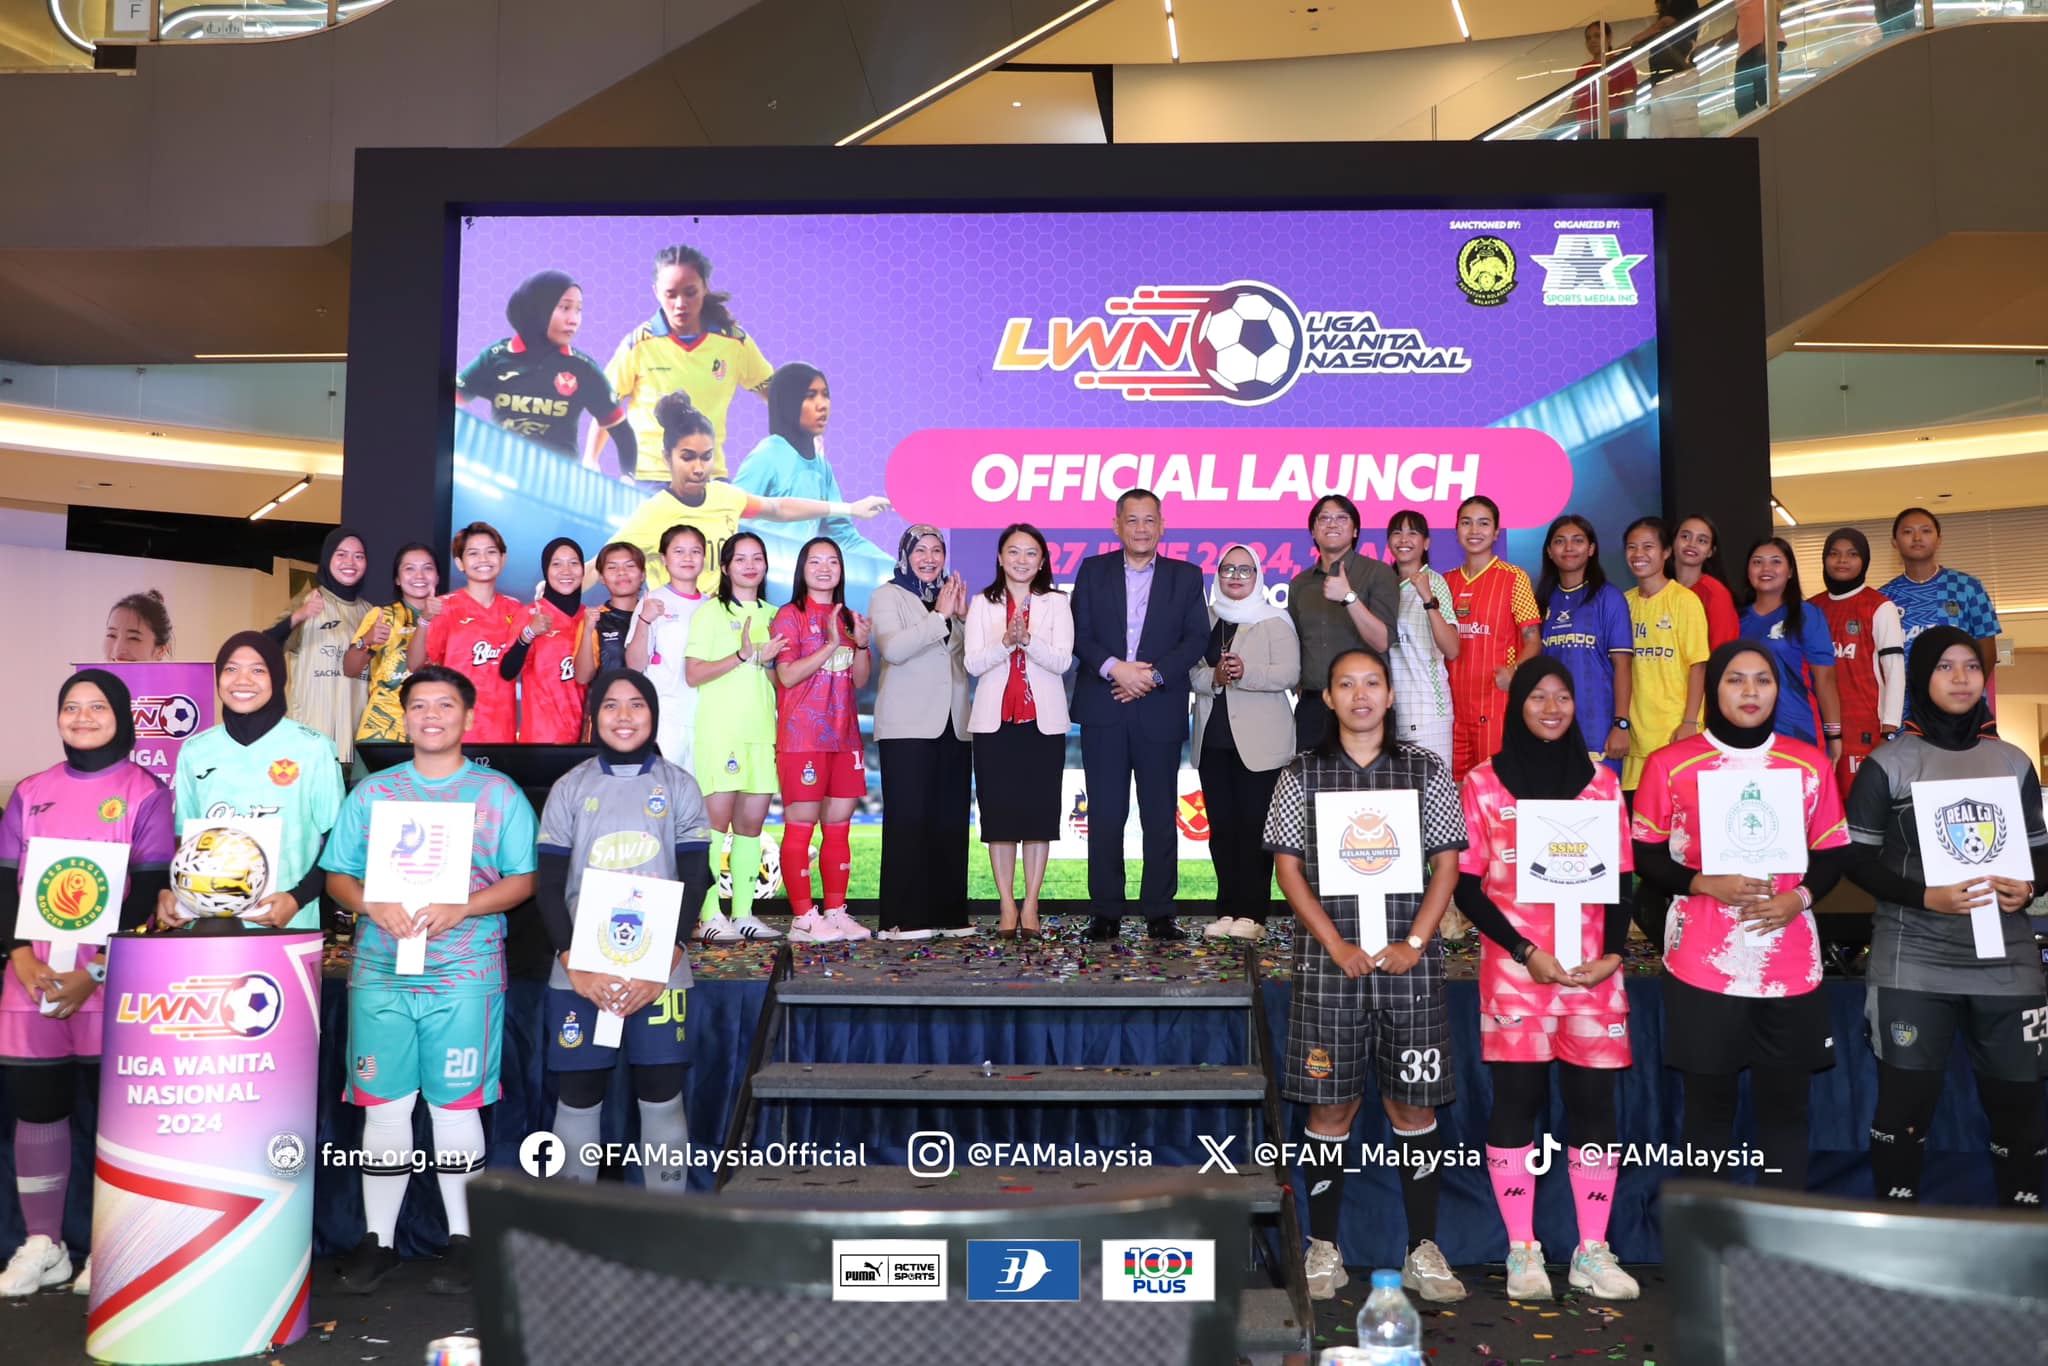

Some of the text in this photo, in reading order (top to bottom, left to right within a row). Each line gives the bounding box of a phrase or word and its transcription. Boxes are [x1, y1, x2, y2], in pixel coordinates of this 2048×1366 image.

[1449, 220, 1521, 230] SANCTIONED BY:
[1553, 220, 1620, 230] ORGANIZED BY:
[1546, 294, 1635, 303] SPORTS MEDIA INC
[1306, 315, 1376, 332] LIGA
[999, 321, 1189, 366] LWN
[1307, 333, 1422, 350] WANITA
[1304, 351, 1468, 369] NASIONAL
[494, 393, 569, 417] PKNS
[971, 453, 1480, 502] OFFICIAL LAUNCH
[1634, 622, 1647, 638] 14
[1633, 647, 1674, 658] RADO
[1946, 804, 1976, 823] REAL
[590, 836, 658, 865] SAWIT
[1341, 848, 1398, 857] KELANA UNITED
[1548, 842, 1588, 854] SSMP
[42, 859, 106, 892] RED EAGLES
[38, 895, 102, 928] SOCCER CLUB
[117, 993, 219, 1024] LWN
[117, 1052, 276, 1077] LIGA WANITA
[444, 1047, 479, 1078] 20
[1400, 1048, 1441, 1083] 33
[127, 1081, 261, 1105] NASIONAL
[156, 1112, 223, 1134] 2024
